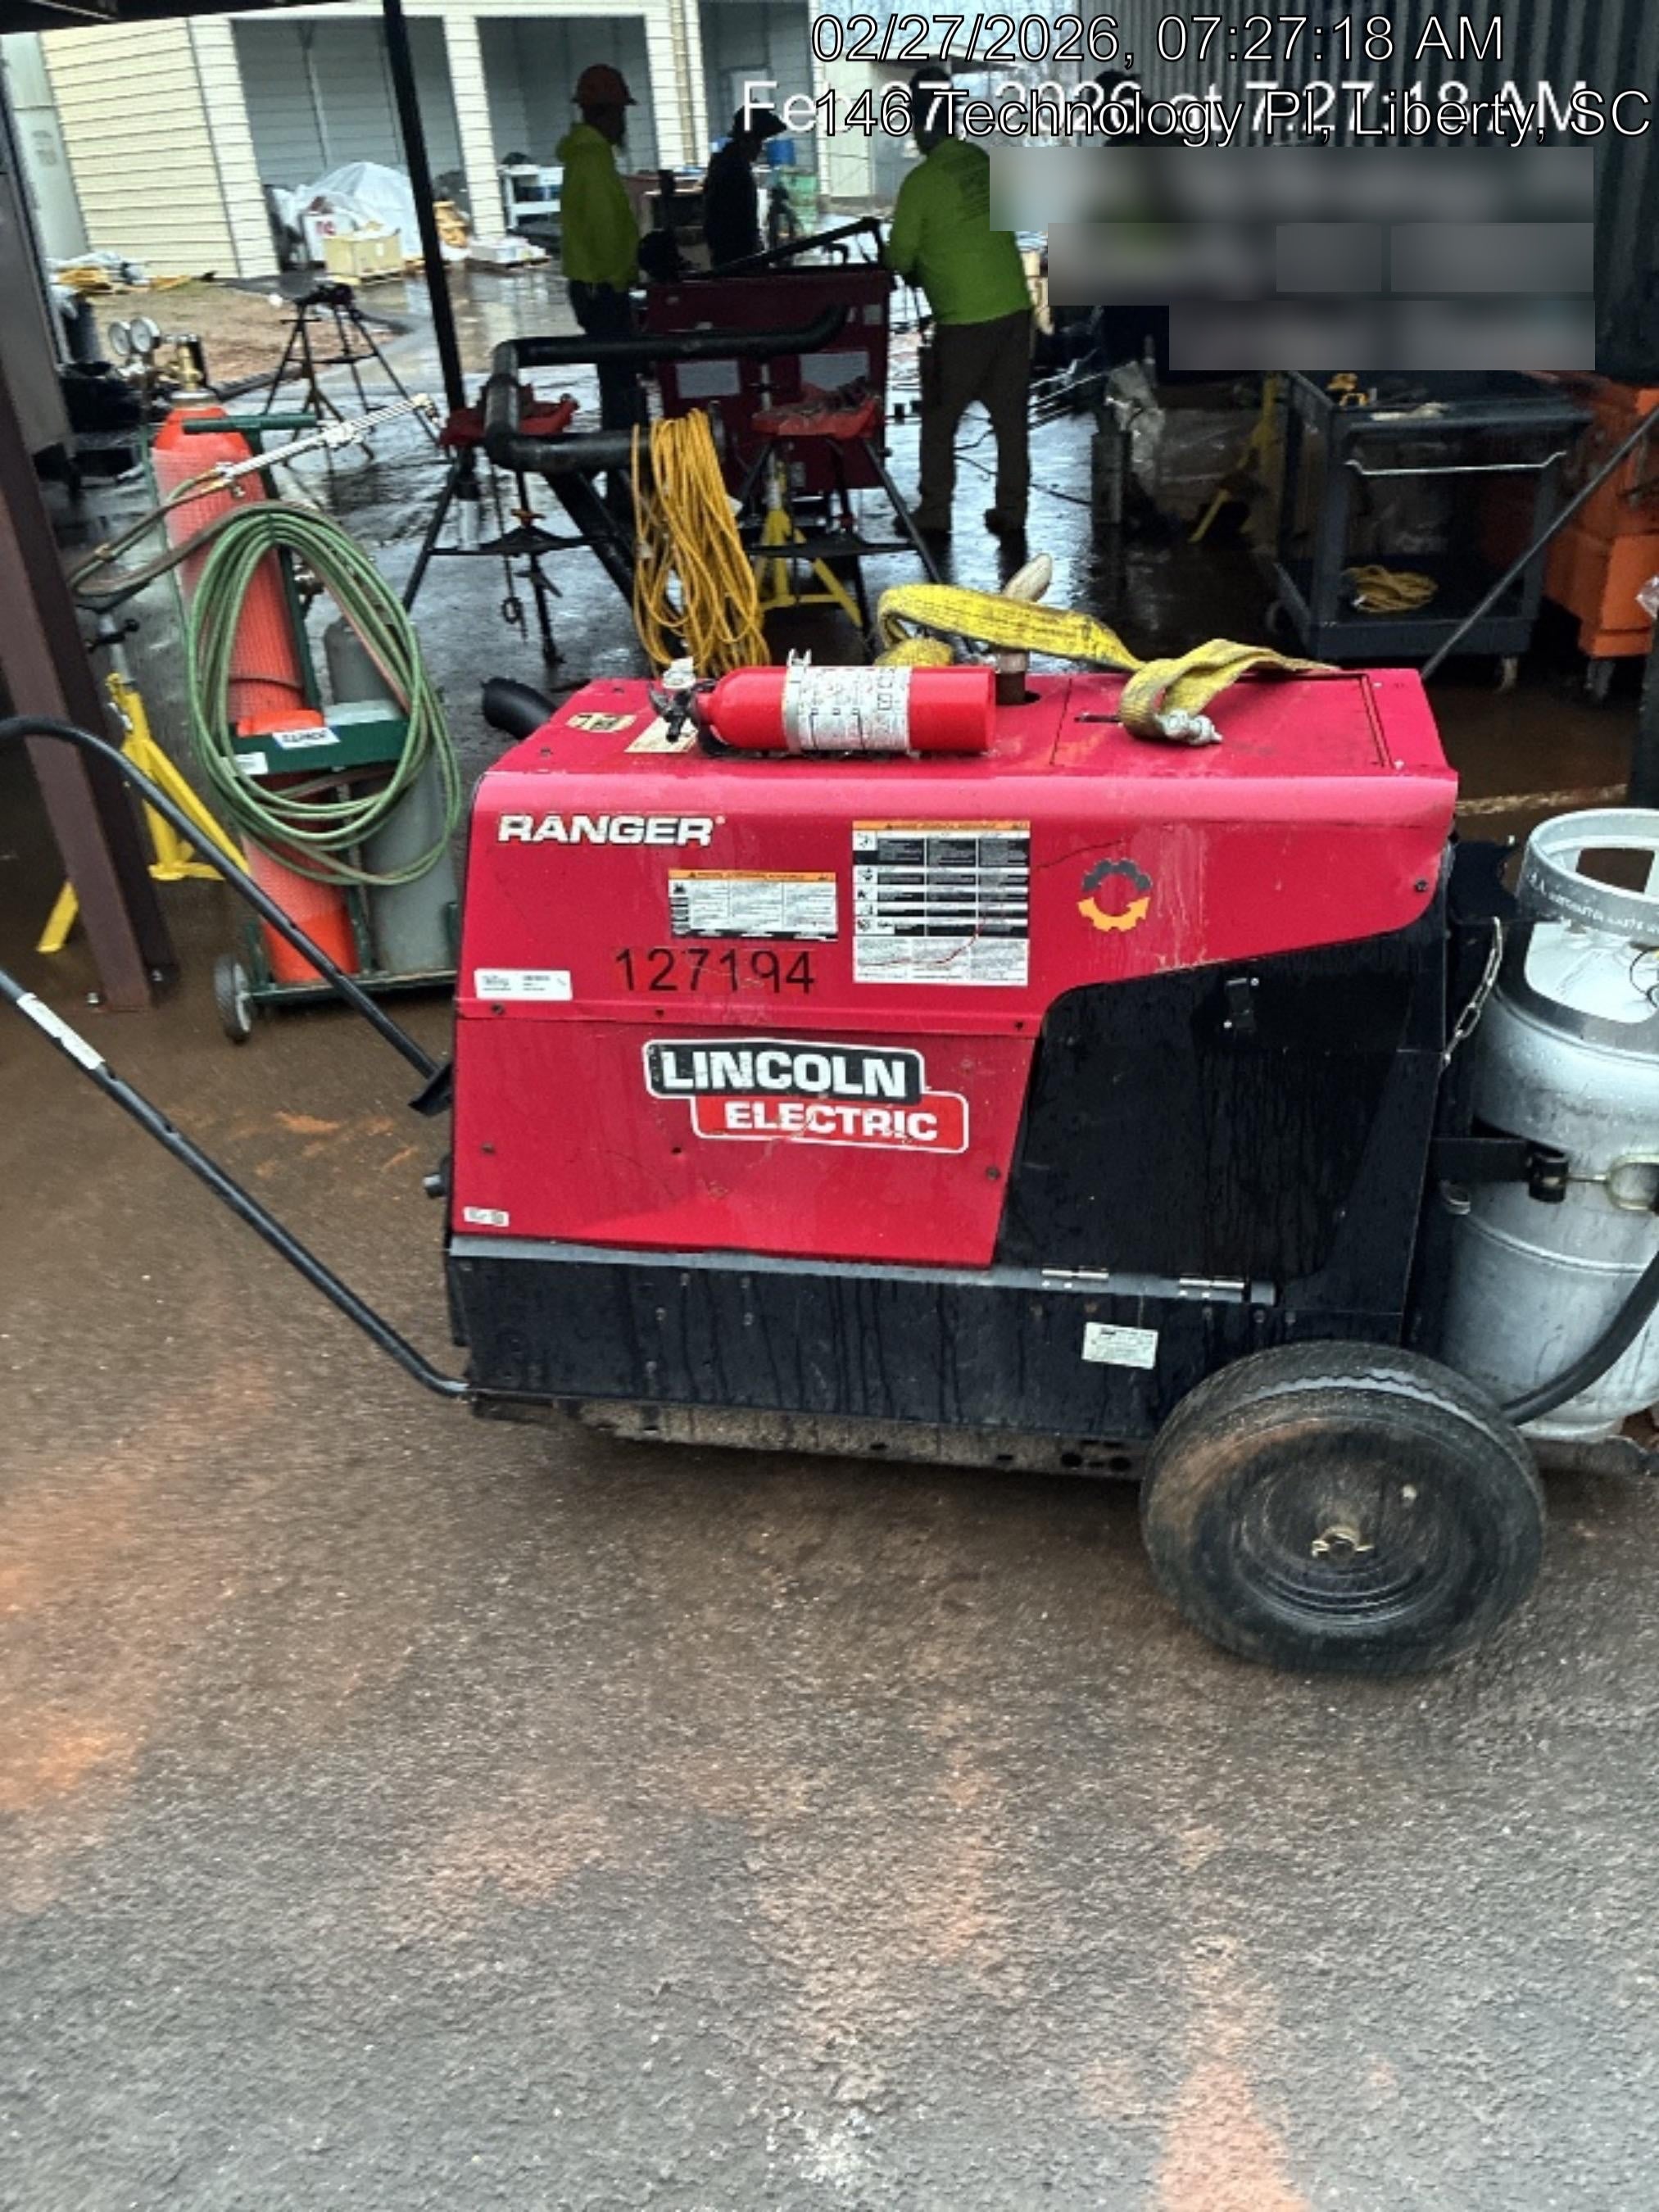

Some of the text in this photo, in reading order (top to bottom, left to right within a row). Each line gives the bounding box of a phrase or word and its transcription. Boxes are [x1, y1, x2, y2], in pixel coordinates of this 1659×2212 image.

[497, 814, 714, 847] RANGER
[615, 947, 815, 995] 127194
[660, 1049, 907, 1099] LINCOLN
[723, 1100, 939, 1142] ELECTRIC
